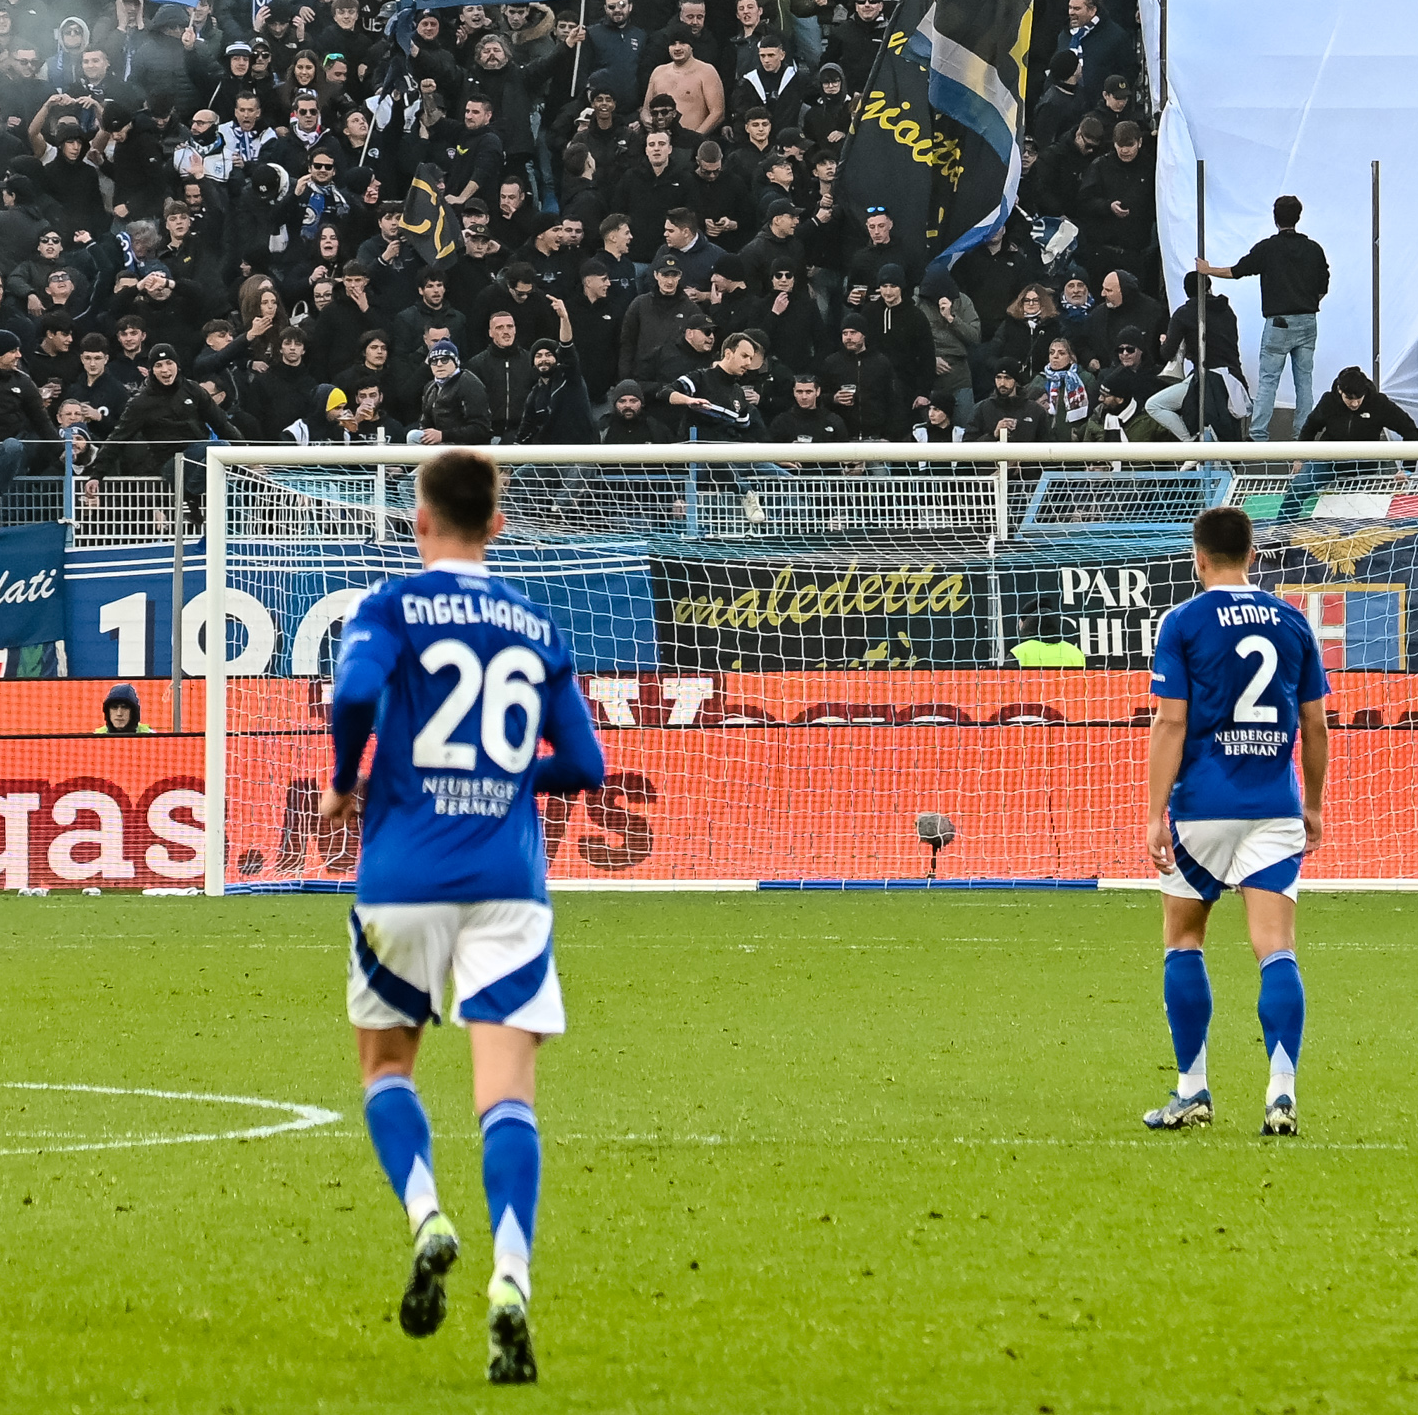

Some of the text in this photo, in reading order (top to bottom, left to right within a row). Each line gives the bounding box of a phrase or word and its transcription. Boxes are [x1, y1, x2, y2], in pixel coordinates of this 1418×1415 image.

[675, 559, 972, 630] maledetta
[1061, 566, 1150, 609] PAR
[401, 592, 552, 649] ENGELHARDT
[1216, 603, 1282, 629] KEMPF
[1233, 634, 1279, 724] 2
[411, 638, 547, 775] 26
[1214, 728, 1289, 744] NEUBERGER
[1224, 743, 1278, 757] BERMAN
